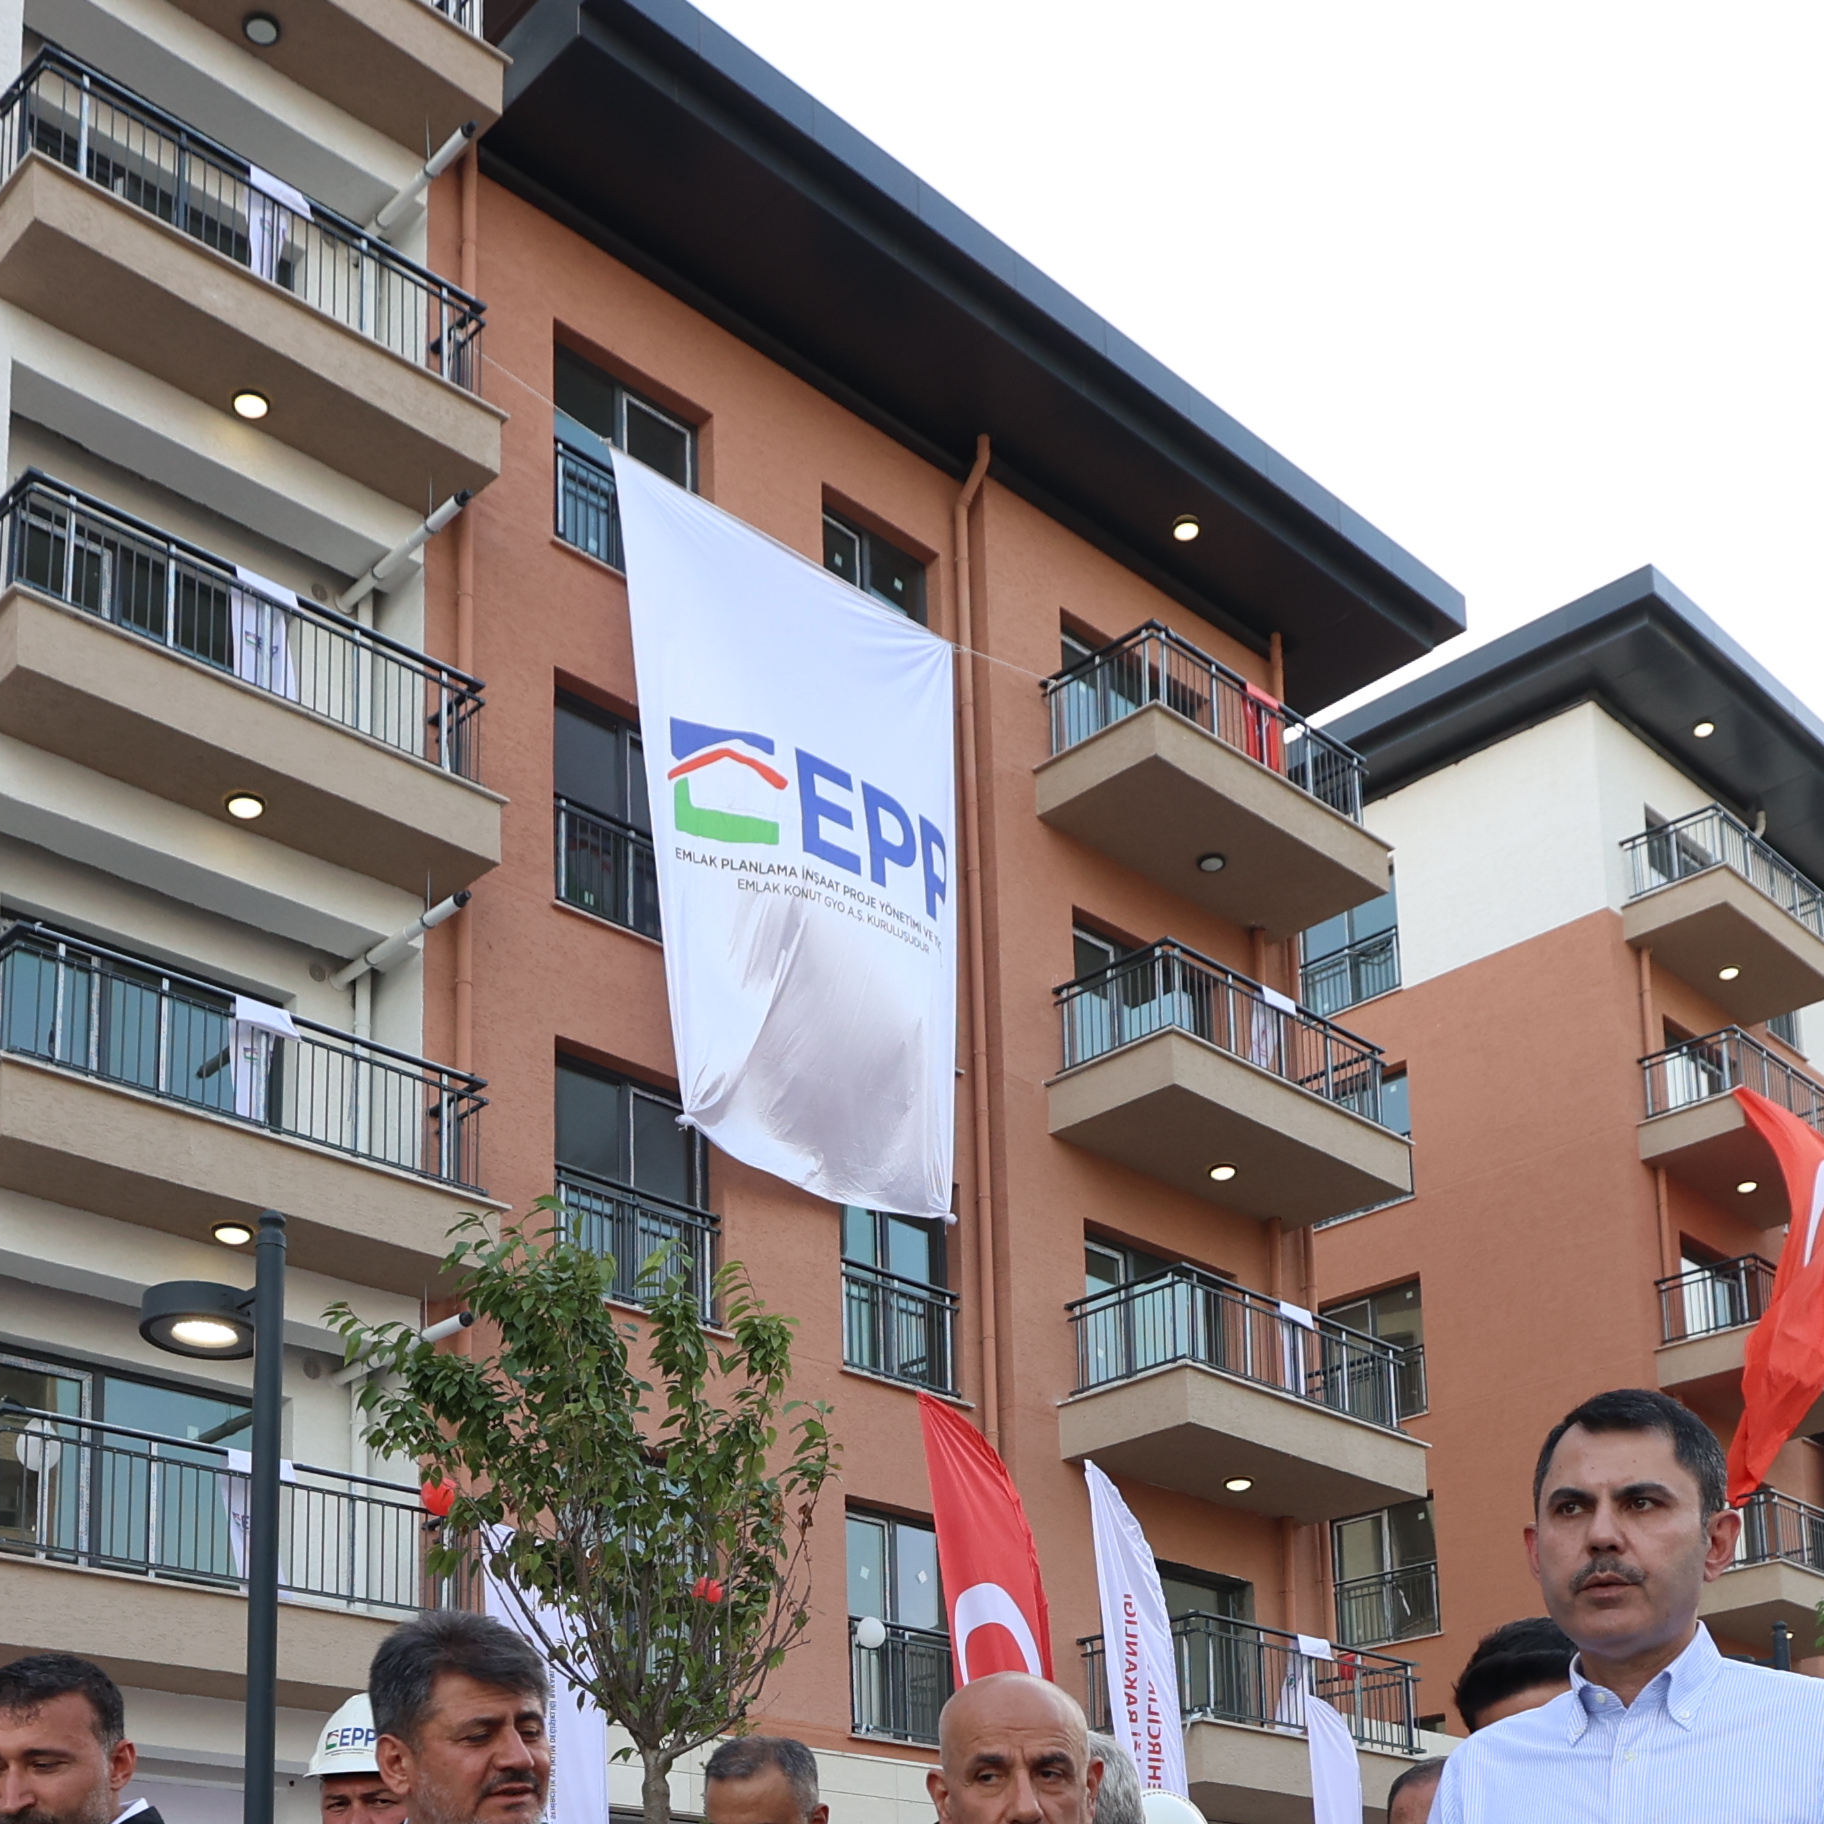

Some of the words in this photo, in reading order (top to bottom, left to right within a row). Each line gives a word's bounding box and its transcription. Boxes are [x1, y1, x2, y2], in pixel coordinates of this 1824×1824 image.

[794, 746, 948, 922] EPP
[675, 847, 718, 868] EMLAK
[721, 858, 798, 878] PLANLAMA
[801, 865, 840, 893] İNŞAAT
[843, 885, 877, 909] PROJE
[879, 900, 922, 934] YÖNETİMİ
[737, 878, 780, 894] EMLAK
[784, 883, 822, 904] KONUT
[824, 895, 846, 914] GYO
[867, 913, 930, 955] KURULUŞUDUR
[339, 1727, 377, 1747] EPP
